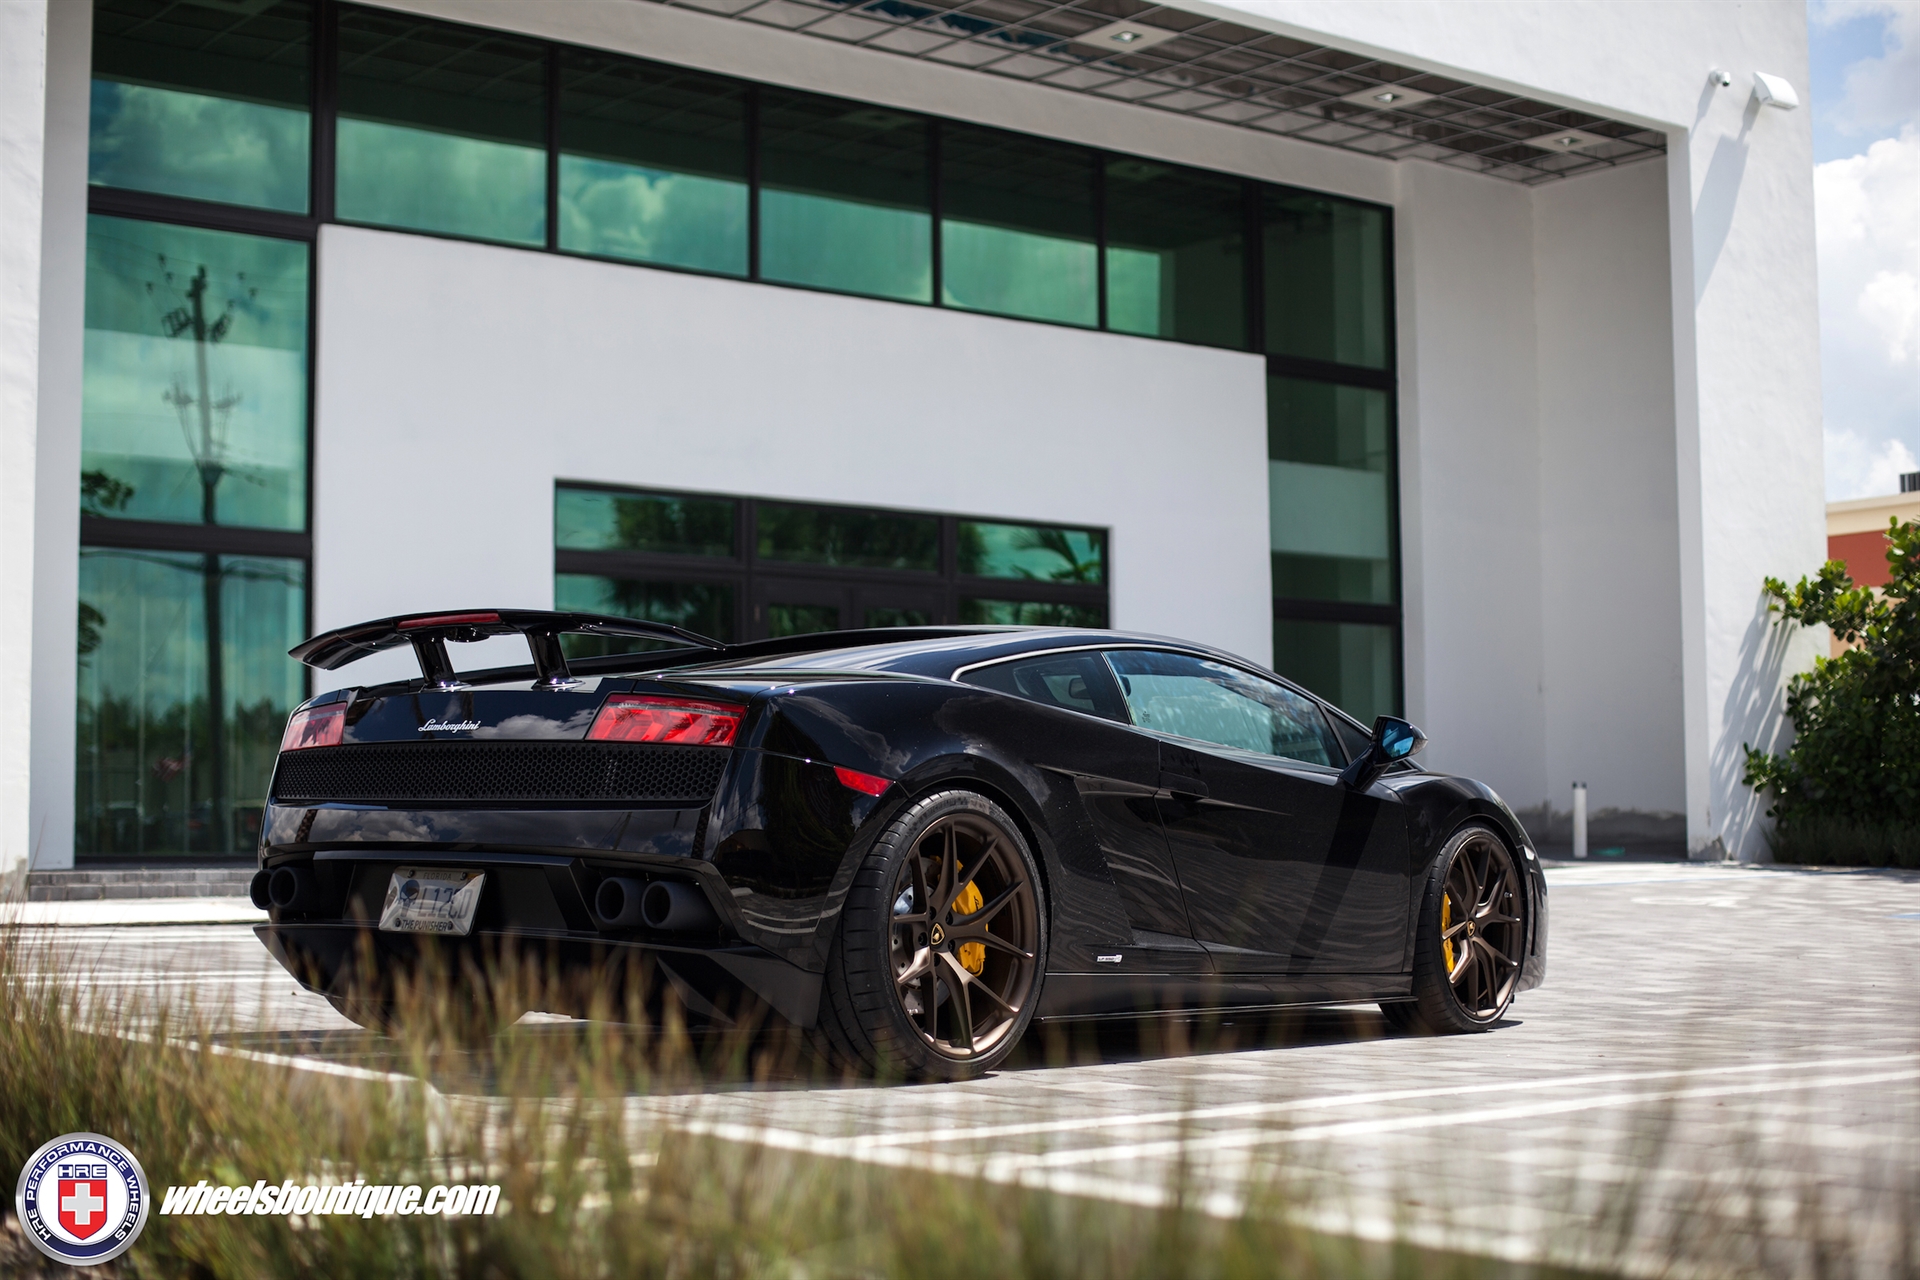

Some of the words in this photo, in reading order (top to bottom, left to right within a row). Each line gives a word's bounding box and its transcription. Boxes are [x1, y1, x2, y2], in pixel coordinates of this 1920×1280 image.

[418, 718, 481, 733] Lamborghini
[423, 872, 452, 880] FLORIDA
[401, 920, 414, 929] THE
[414, 920, 447, 931] PUNISHER
